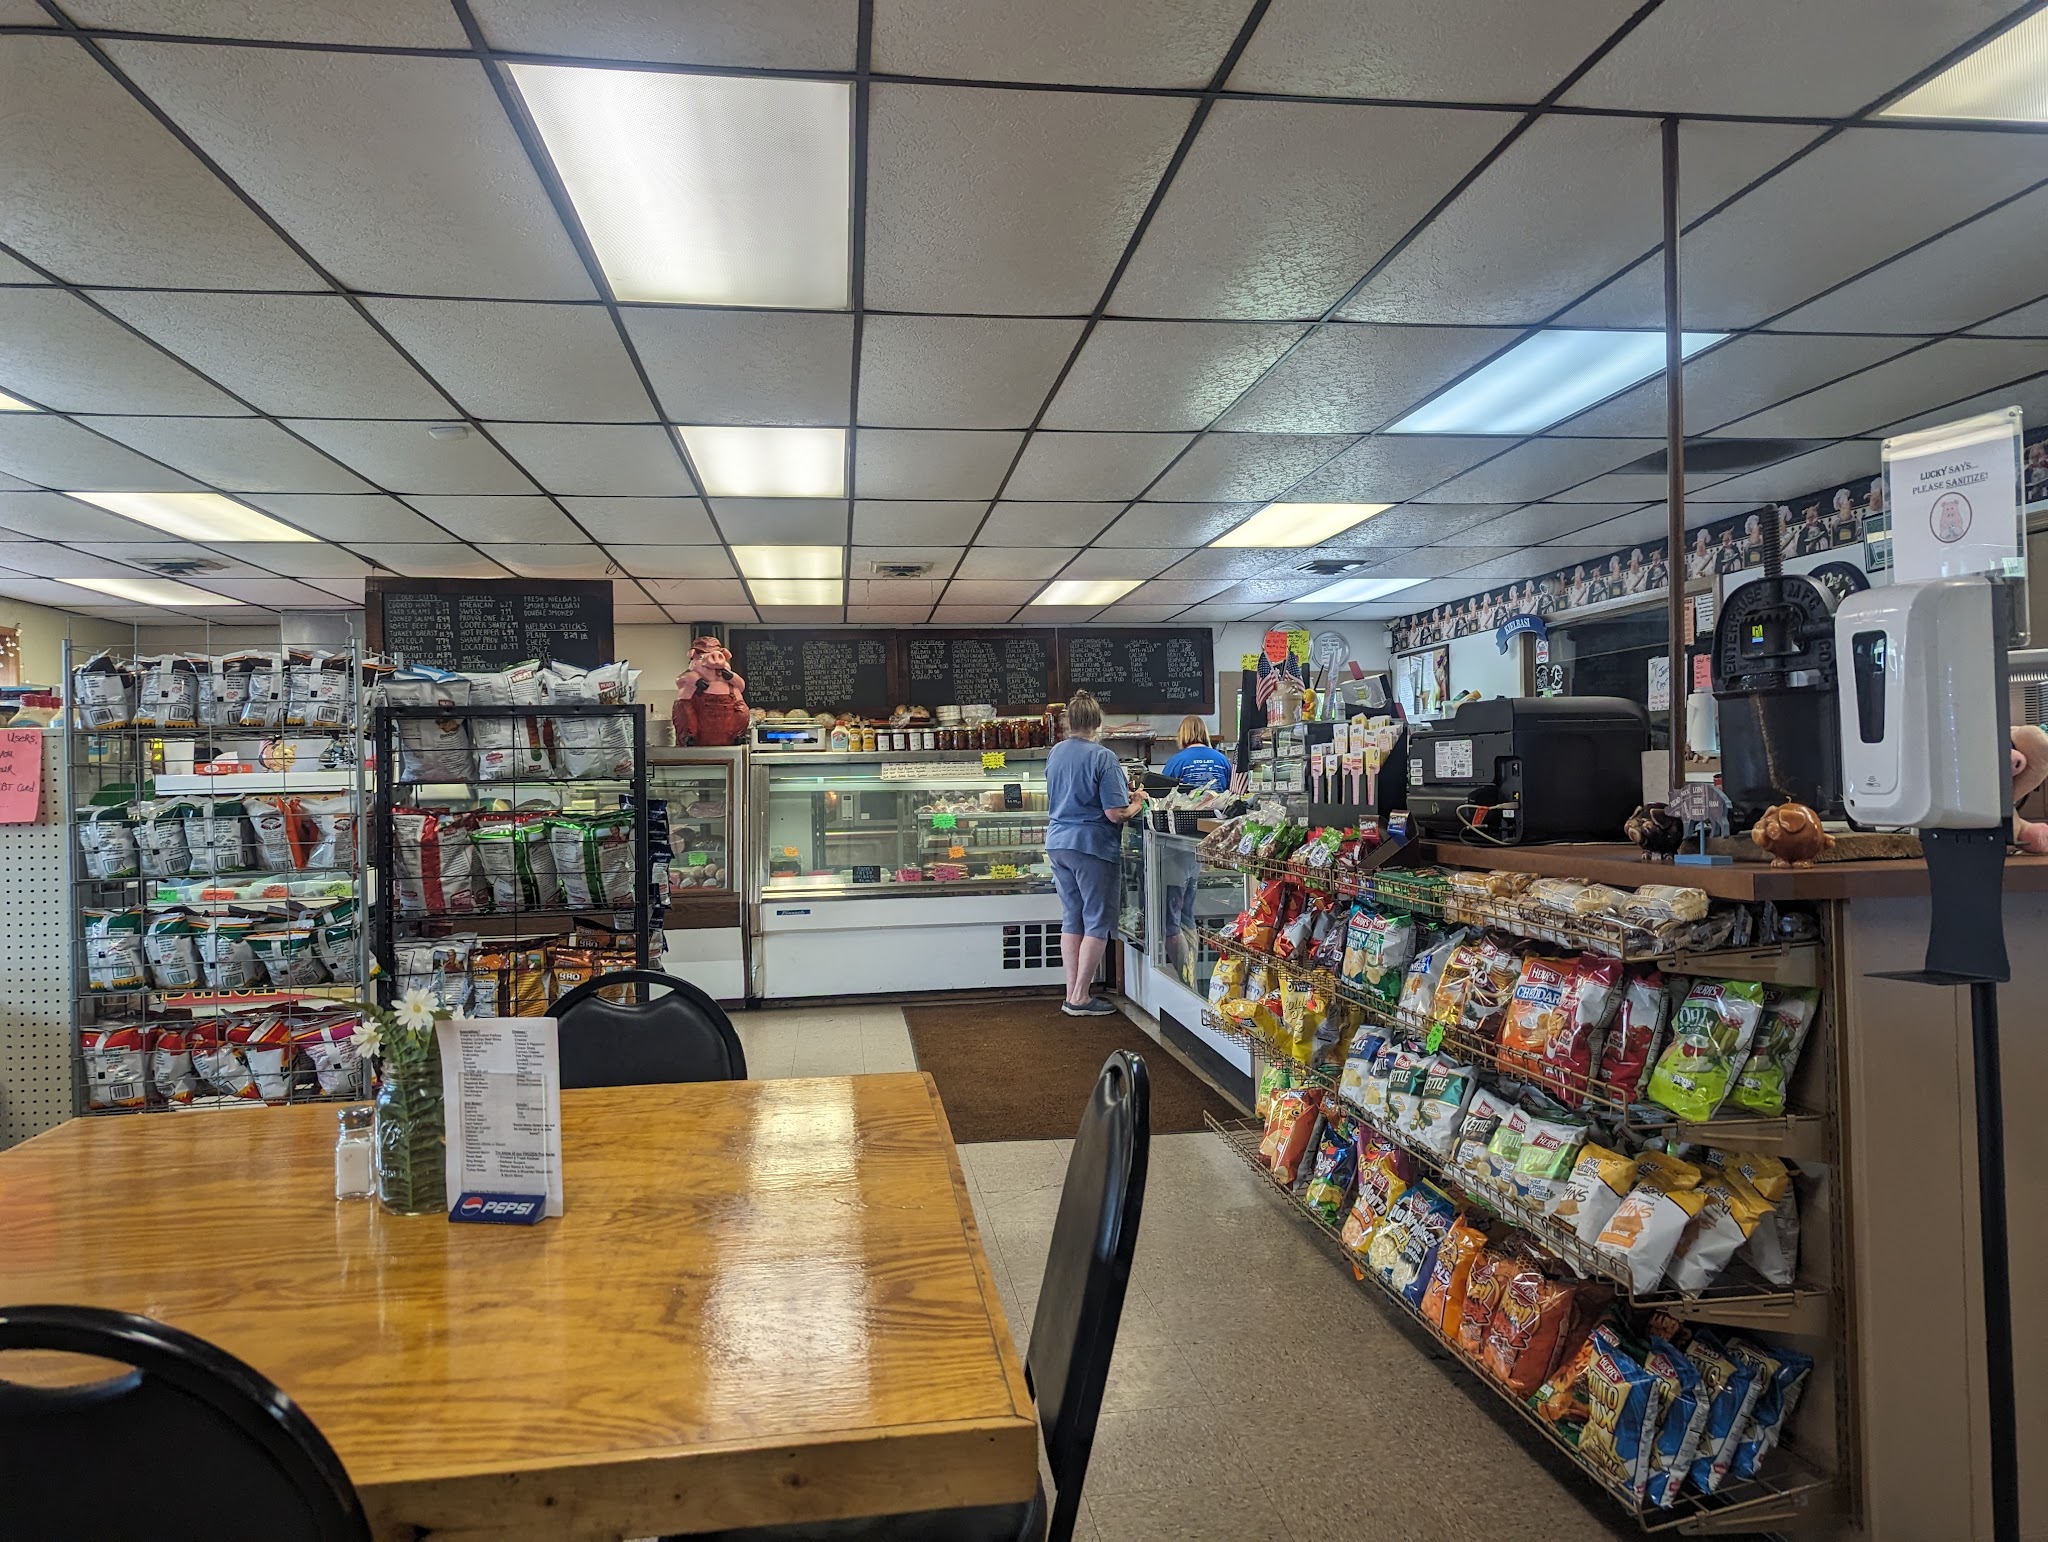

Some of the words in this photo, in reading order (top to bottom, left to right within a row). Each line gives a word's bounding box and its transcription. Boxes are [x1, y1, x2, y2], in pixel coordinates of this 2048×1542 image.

[1920, 466, 1948, 480] LUCKY
[1912, 481, 1944, 495] PLEASE
[1945, 472, 1989, 489] SANITIZE!
[560, 622, 587, 630] STICKS
[1503, 617, 1531, 635] KIELBASI
[525, 638, 551, 646] CHEESE
[1708, 800, 1719, 808] HAM
[1691, 808, 1705, 816] BELLY
[558, 972, 580, 981] BBQ
[1532, 967, 1557, 983] HERR'S
[1516, 986, 1561, 1006] CHEDDAR
[1692, 984, 1719, 997] HERR'S
[1459, 1115, 1491, 1136] KETTLE
[1536, 1135, 1561, 1150] HERR'S
[481, 1201, 535, 1215] PEPSI
[1599, 1355, 1620, 1382] HERR'S
